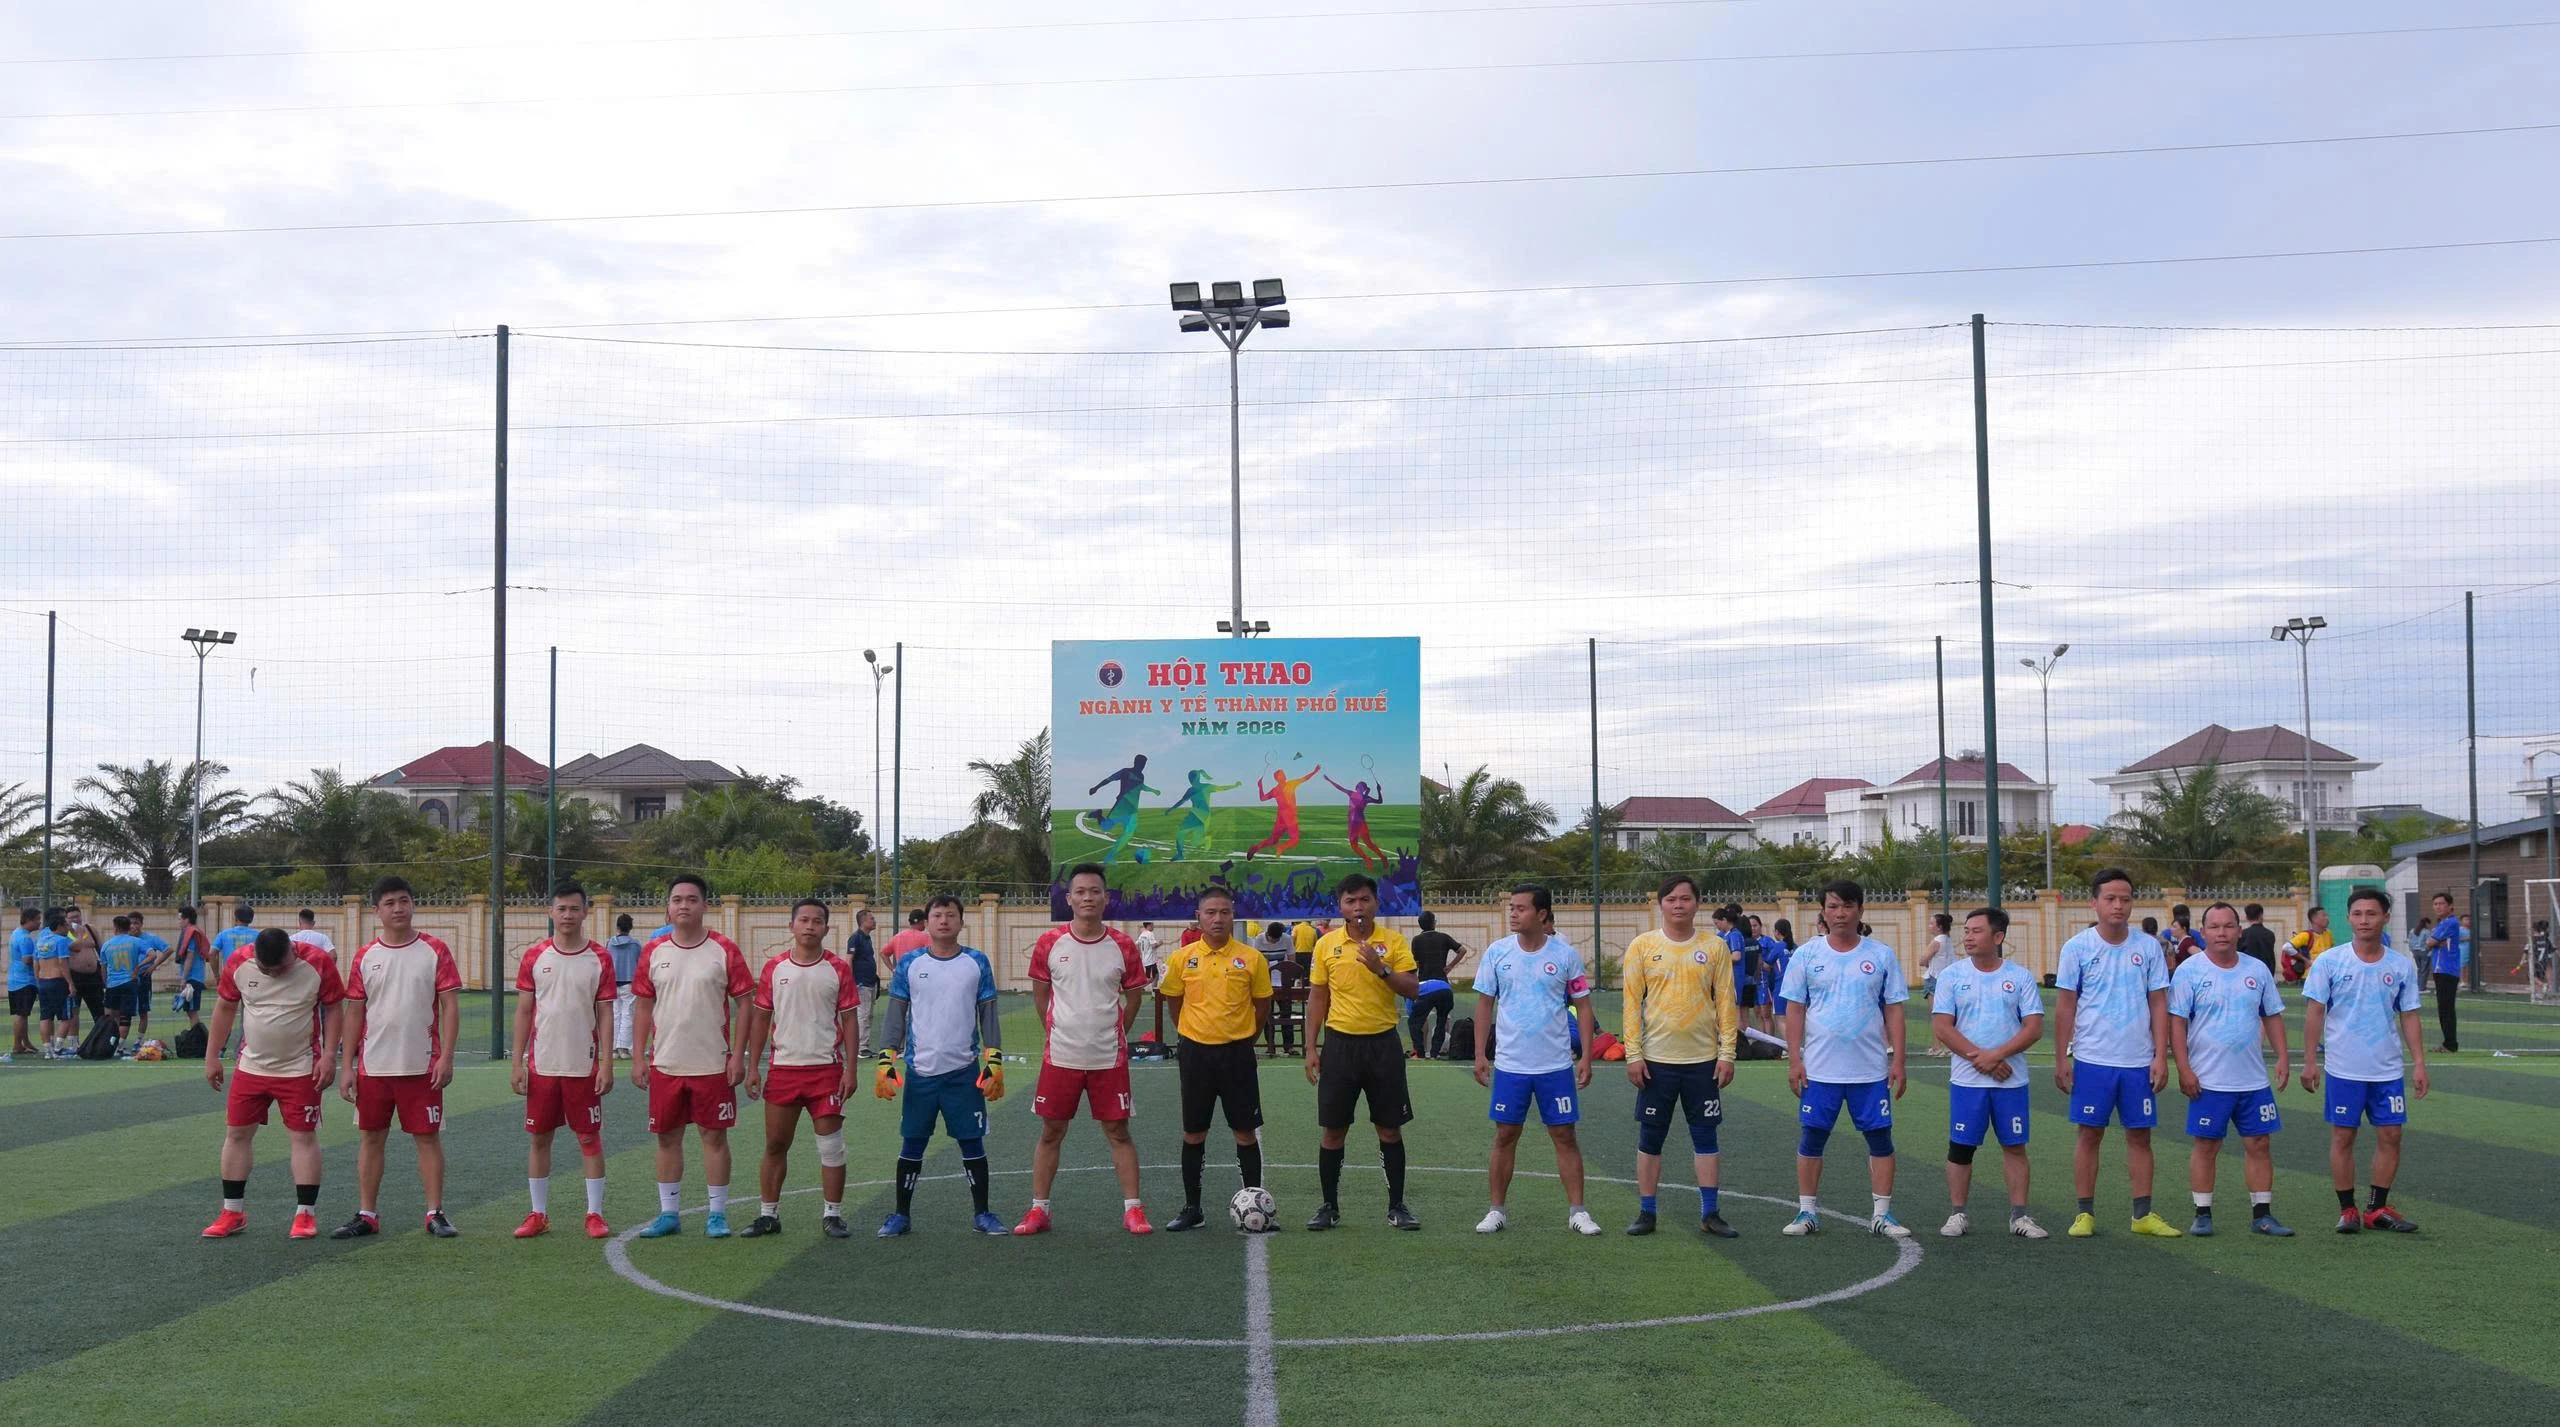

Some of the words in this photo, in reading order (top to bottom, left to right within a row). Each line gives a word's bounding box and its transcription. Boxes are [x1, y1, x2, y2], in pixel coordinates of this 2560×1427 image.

[1147, 656, 1206, 692] HỘI
[1219, 662, 1312, 685] THAO
[1079, 696, 1152, 714] NGÀNH
[1159, 699, 1173, 713] Y
[1181, 691, 1207, 712] TẾ
[1214, 694, 1288, 712] THÀNH
[1296, 690, 1337, 712] PHỐ
[1345, 689, 1387, 712] HUẾ
[1181, 717, 1229, 735] NĂM
[1236, 721, 1286, 735] 2026
[718, 1102, 734, 1121] 20
[1555, 1096, 1572, 1114] 10
[1704, 1099, 1720, 1117] 22
[1879, 1099, 1889, 1116] 2
[2143, 1098, 2152, 1115] 8
[2259, 1103, 2277, 1122] 99
[2388, 1096, 2404, 1113] 18
[426, 1105, 440, 1124] 16
[588, 1105, 601, 1124] 19
[974, 1111, 983, 1128] 7
[2012, 1117, 2022, 1133] 6
